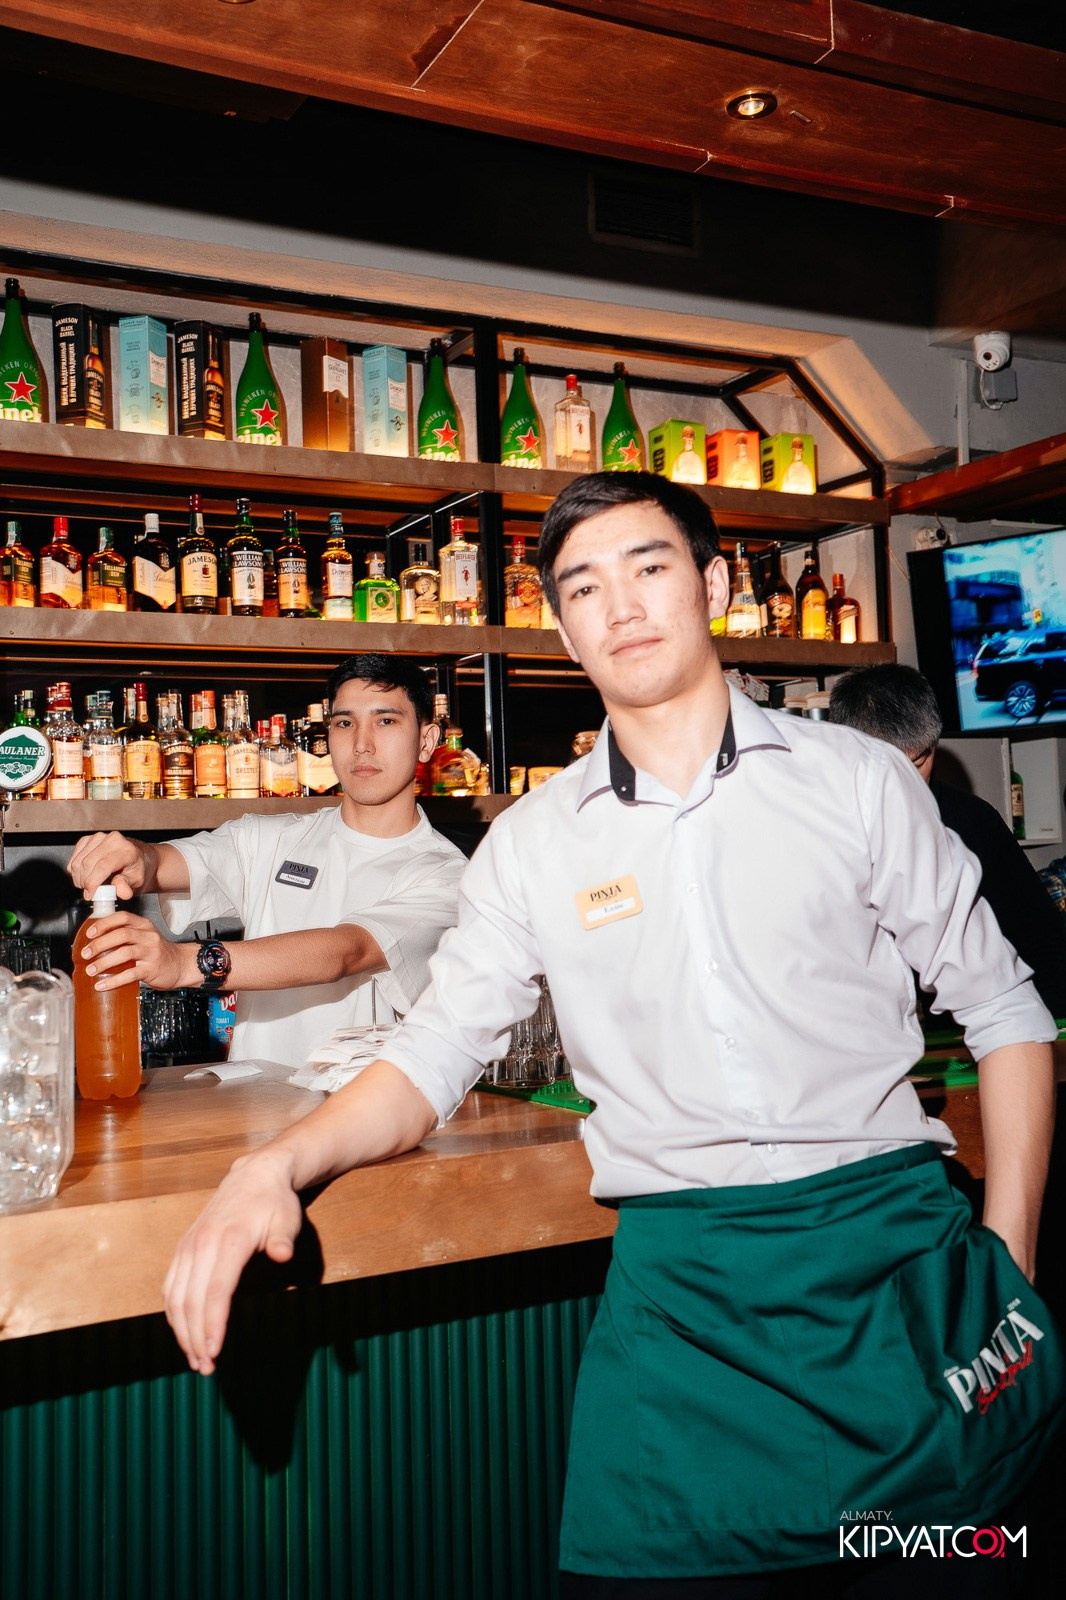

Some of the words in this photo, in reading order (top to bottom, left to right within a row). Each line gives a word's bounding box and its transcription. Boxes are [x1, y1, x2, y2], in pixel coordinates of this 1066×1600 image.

[177, 333, 199, 344] JAMESON
[239, 389, 266, 417] HEINEKEN
[187, 555, 217, 565] JAMESO
[589, 884, 622, 902] PINTA
[945, 1308, 1046, 1414] PINTA
